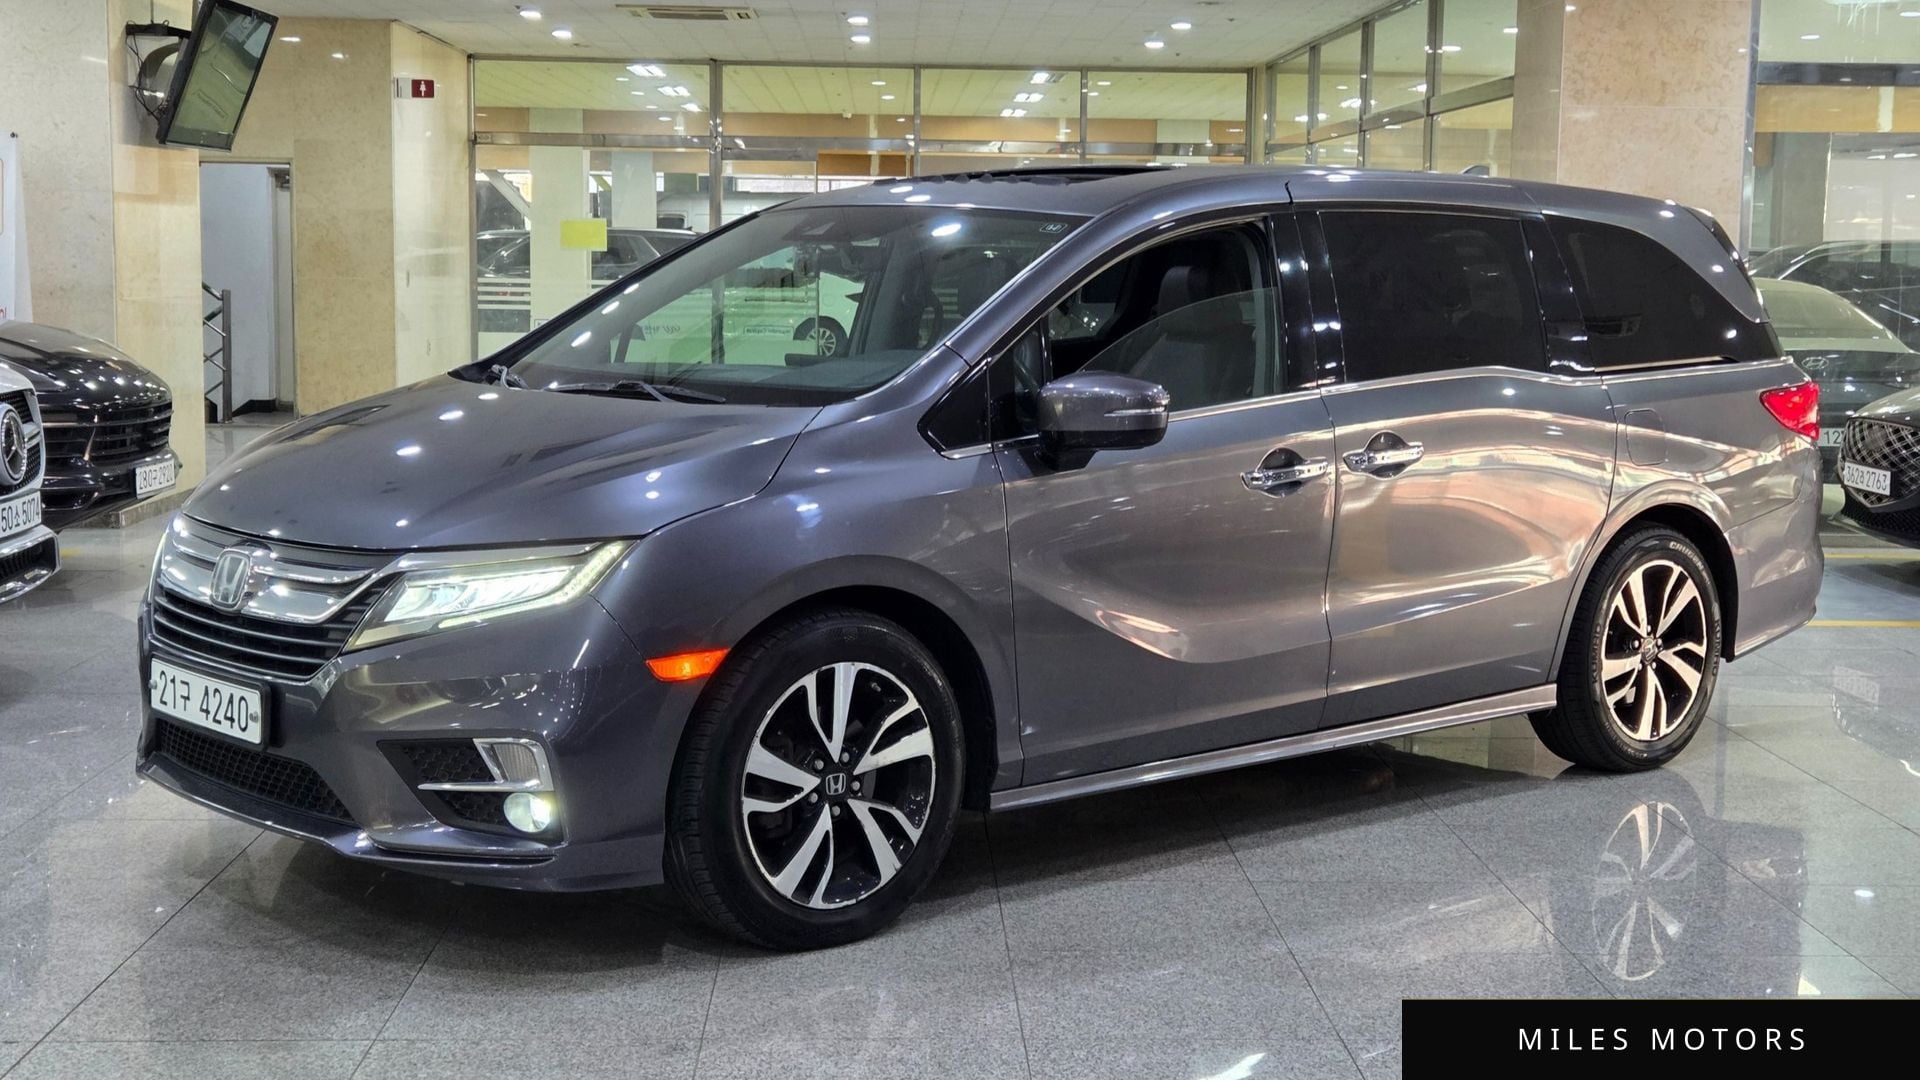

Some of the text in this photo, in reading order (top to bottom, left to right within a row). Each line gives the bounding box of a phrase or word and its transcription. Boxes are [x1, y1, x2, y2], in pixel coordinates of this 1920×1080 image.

[1824, 430, 1844, 444] 12
[21, 496, 40, 525] 5074
[159, 670, 249, 733] 21구 4240
